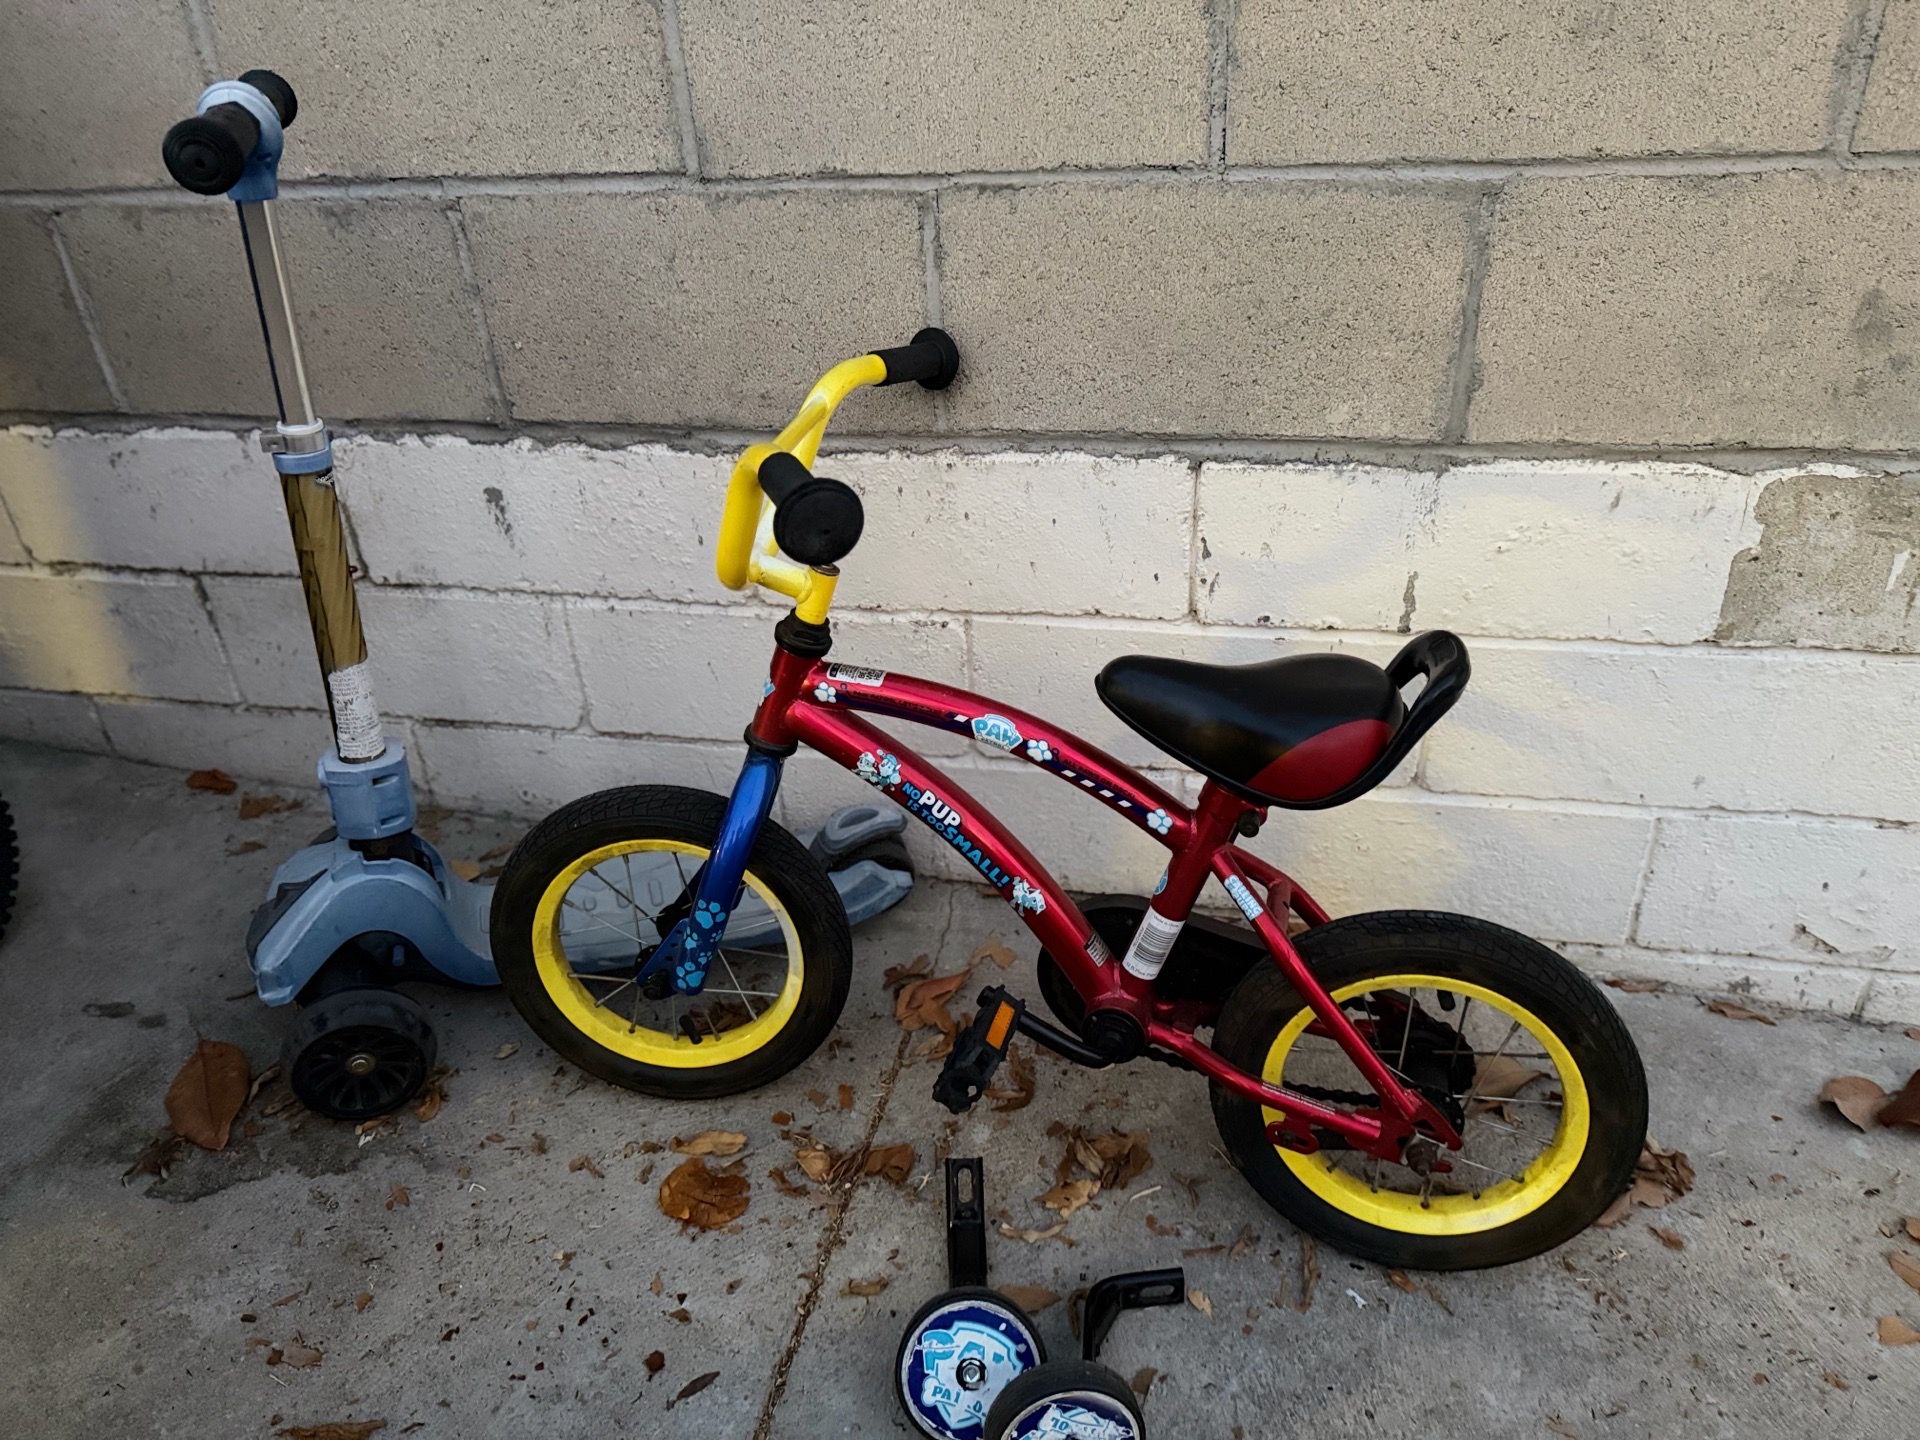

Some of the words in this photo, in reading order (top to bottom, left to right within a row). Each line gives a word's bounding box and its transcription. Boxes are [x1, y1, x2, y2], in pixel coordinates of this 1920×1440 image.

[974, 719, 1021, 747] PAW
[902, 782, 921, 800] NO
[918, 790, 961, 827] PUP
[906, 800, 920, 812] IS
[921, 809, 945, 831] TOO
[943, 826, 1010, 888] SMALL!
